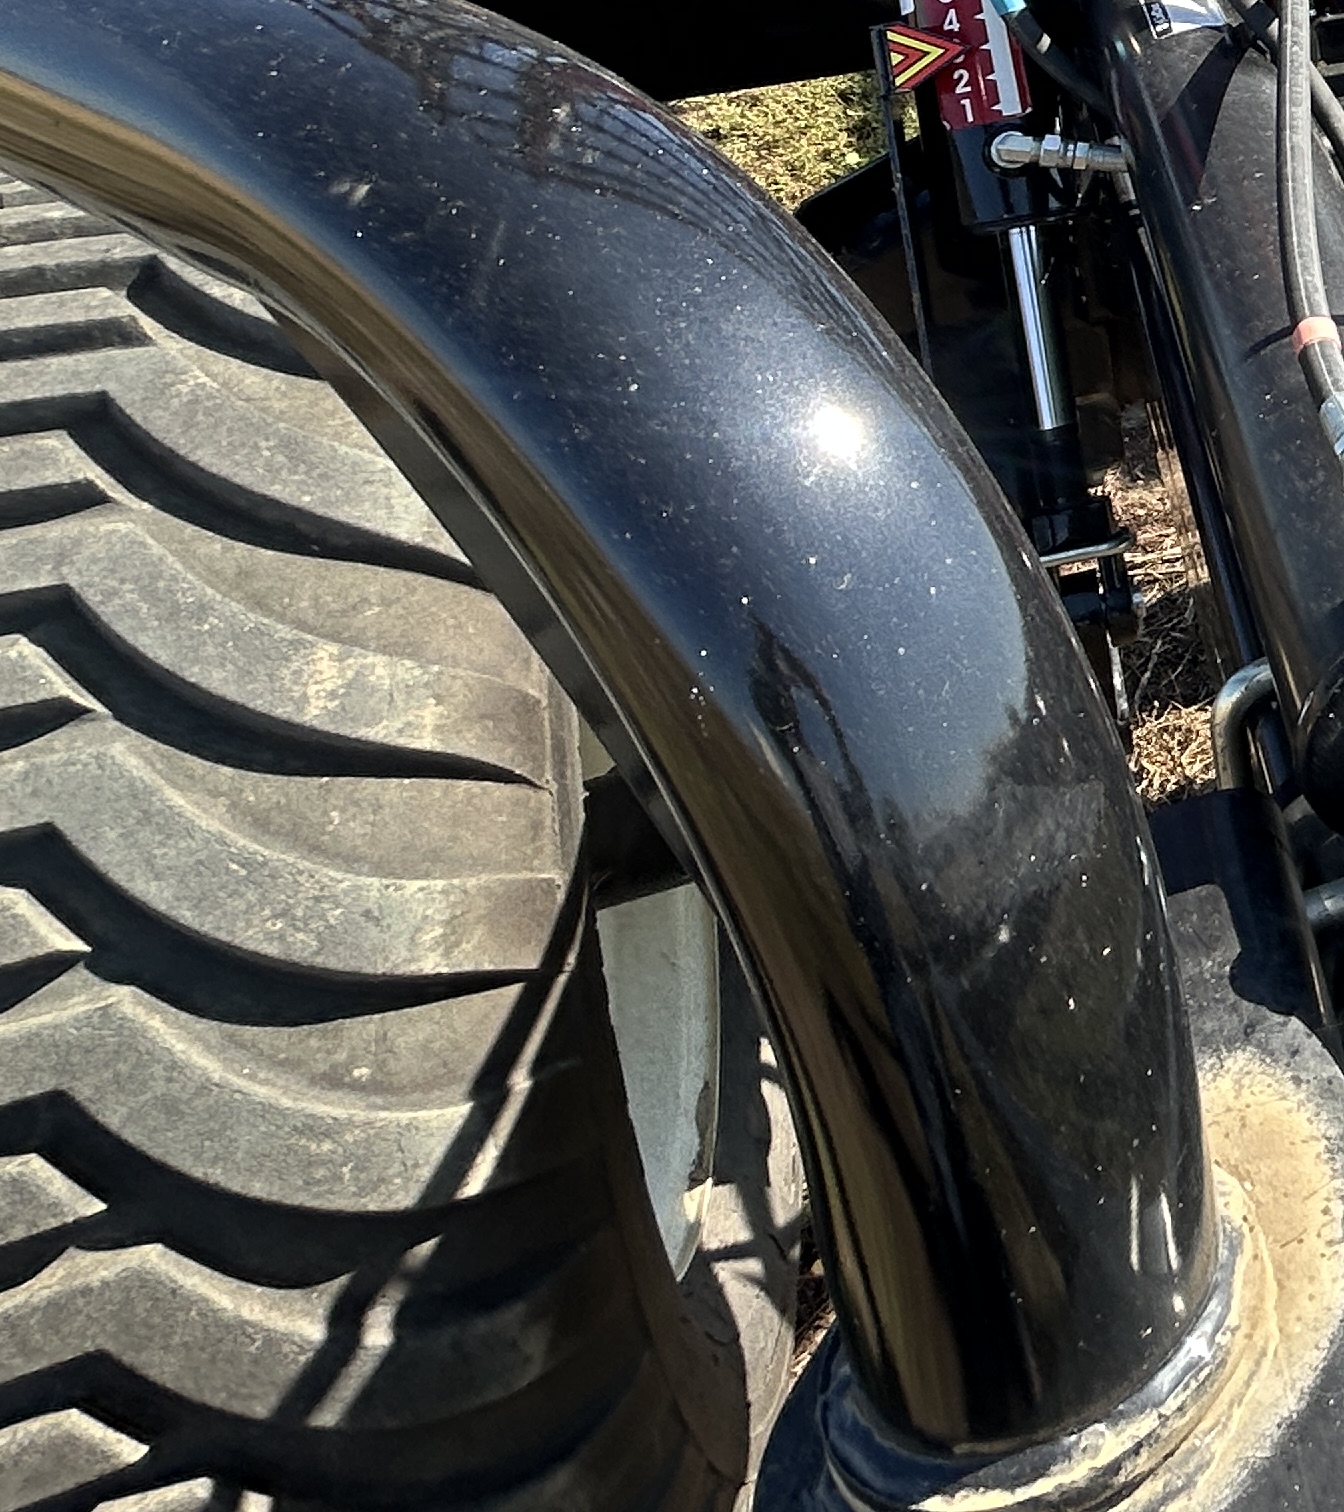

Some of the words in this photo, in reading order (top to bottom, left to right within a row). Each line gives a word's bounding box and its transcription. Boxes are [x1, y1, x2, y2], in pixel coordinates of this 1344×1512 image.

[943, 8, 960, 33] 4
[953, 68, 971, 94] 2
[960, 98, 975, 123] 1
